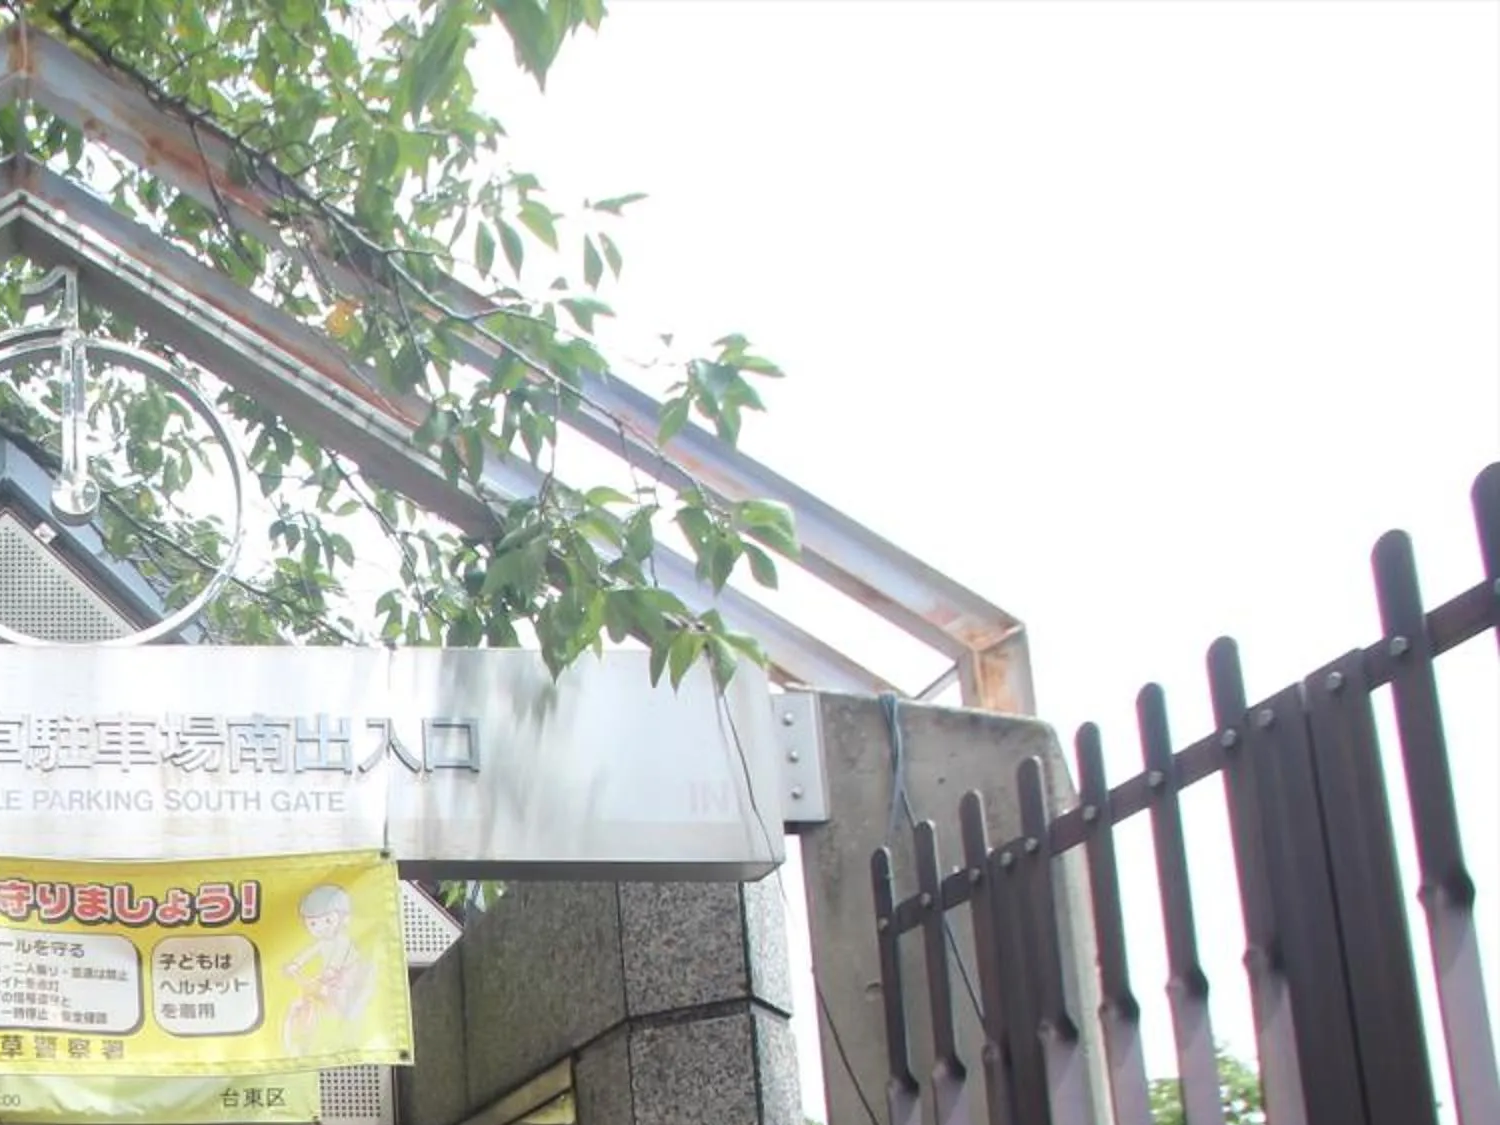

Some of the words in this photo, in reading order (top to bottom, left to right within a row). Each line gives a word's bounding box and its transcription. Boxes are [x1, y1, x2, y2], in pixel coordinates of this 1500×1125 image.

[32, 788, 153, 813] PARKING
[164, 788, 262, 813] SOUTH
[270, 788, 346, 813] GATE
[689, 779, 730, 814] IN
[158, 953, 232, 971] 子どもは
[160, 978, 250, 995] ヘルメット
[219, 1087, 288, 1109] 台東区
